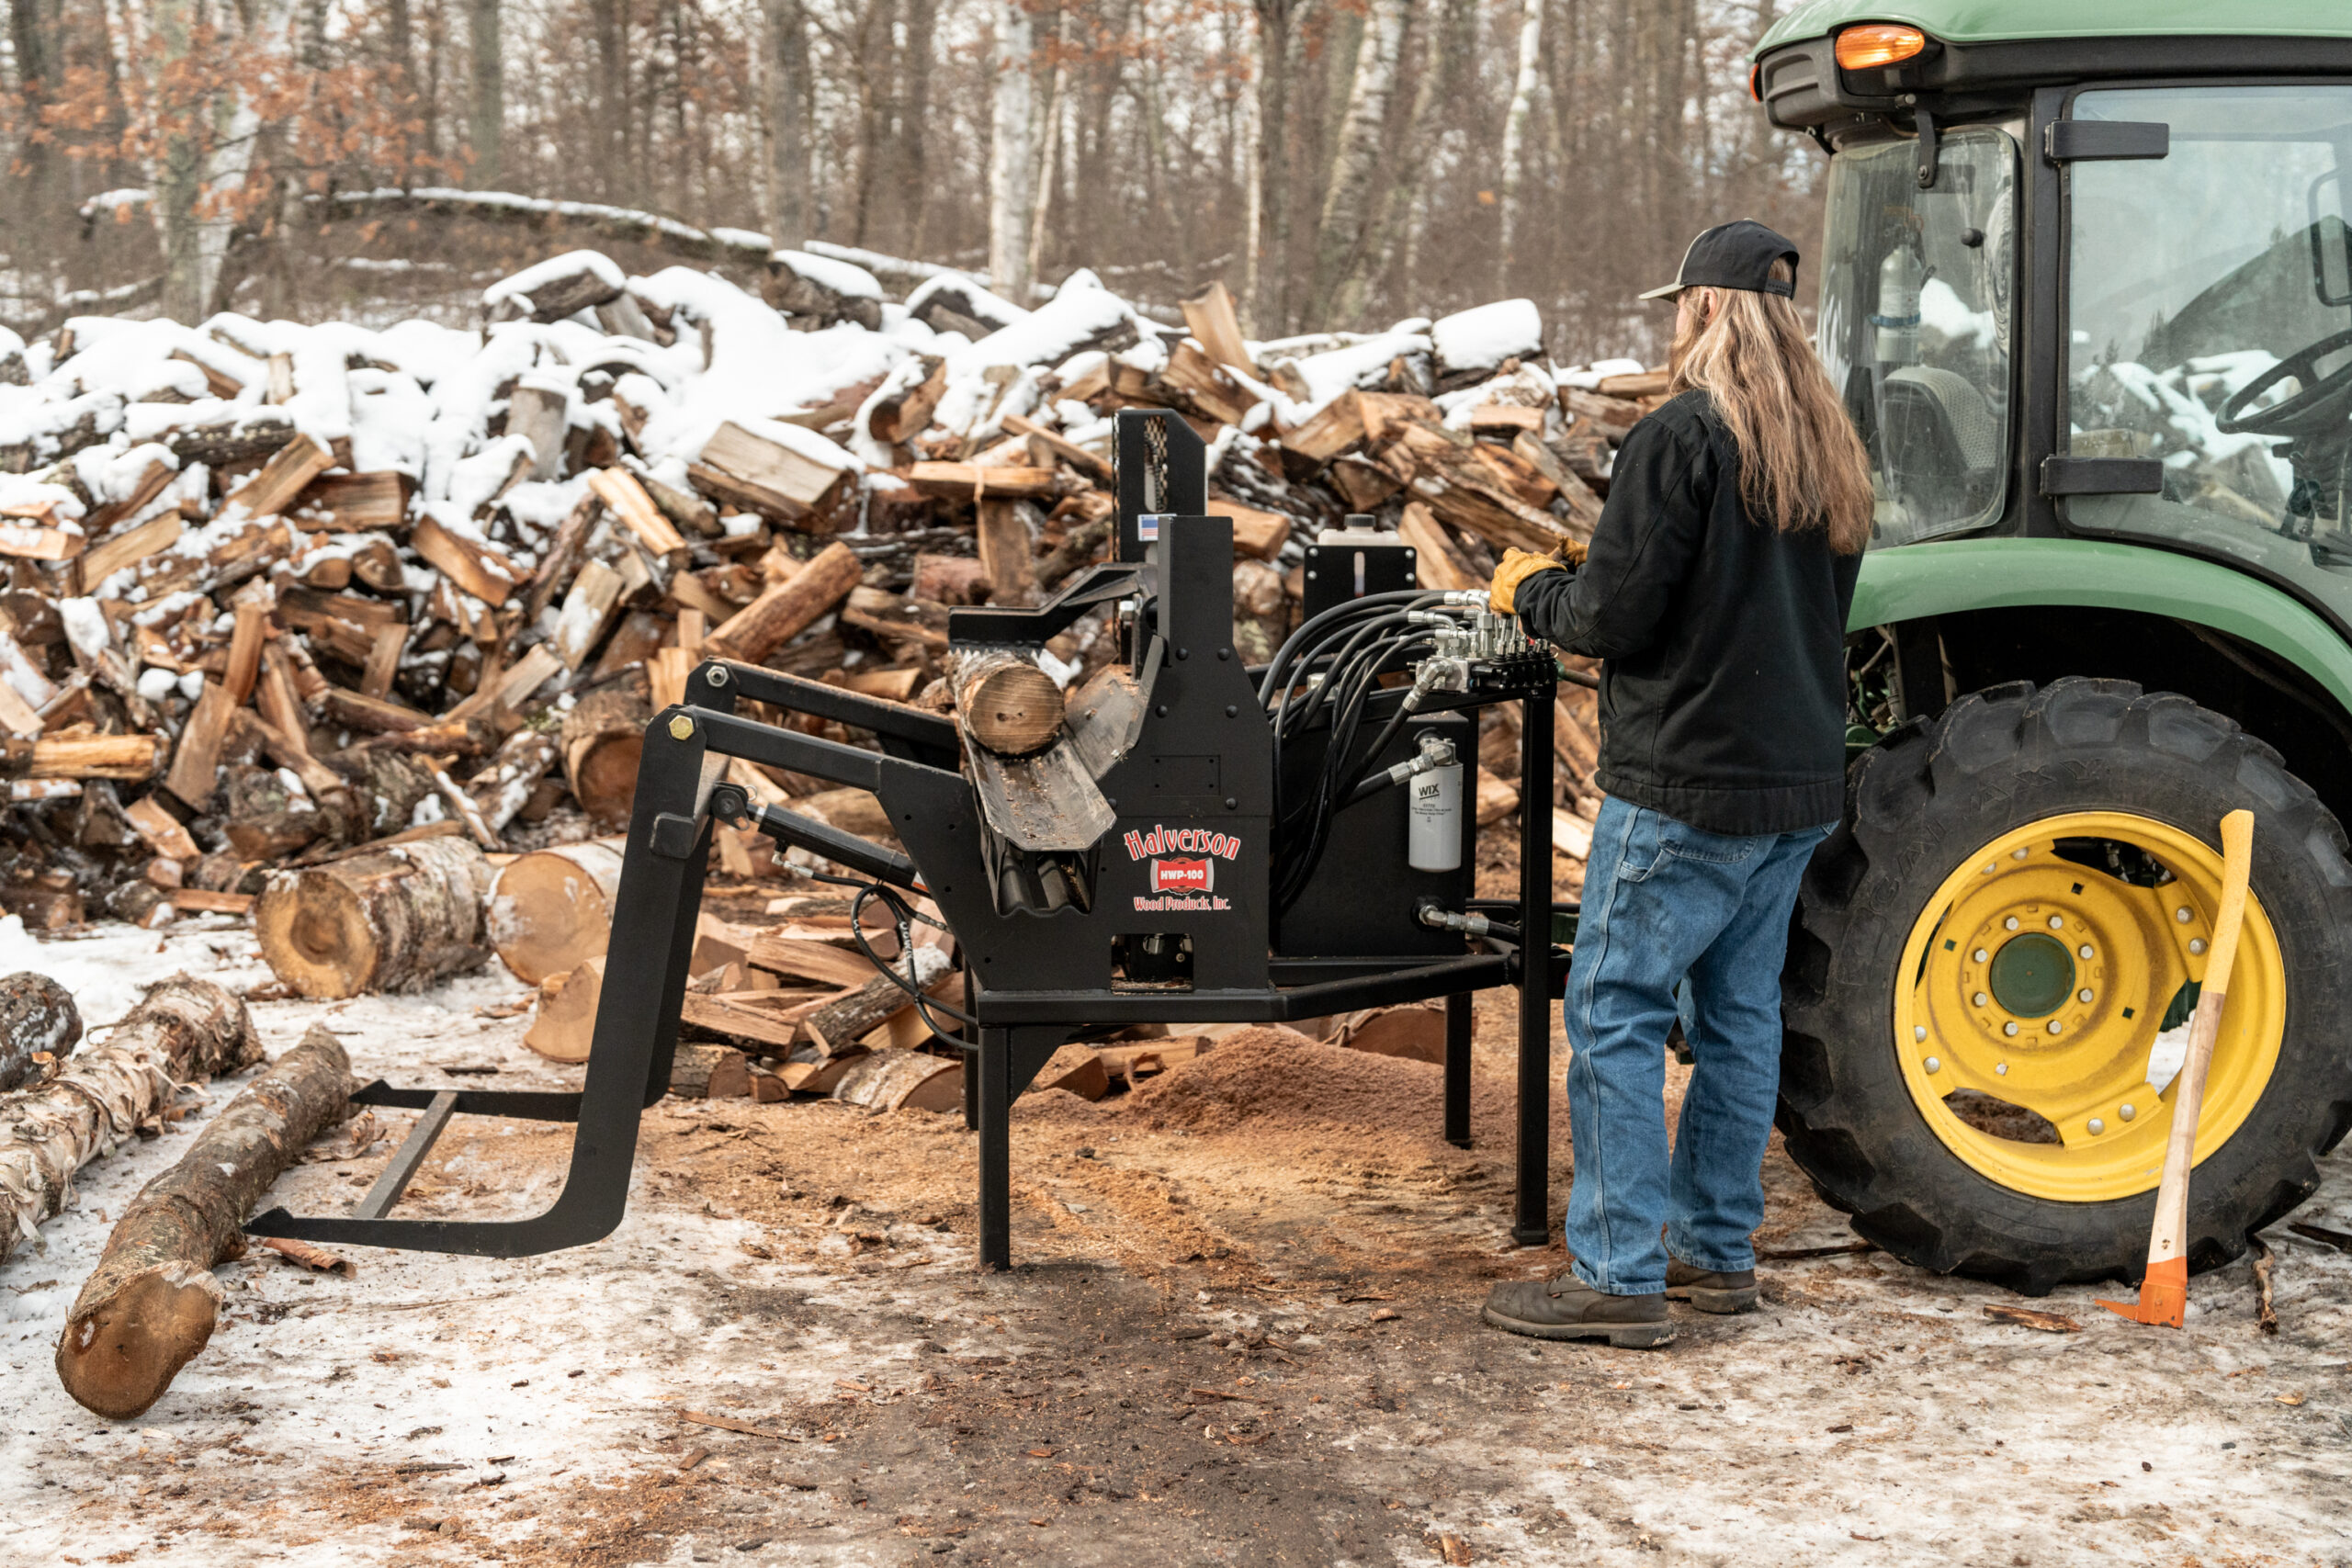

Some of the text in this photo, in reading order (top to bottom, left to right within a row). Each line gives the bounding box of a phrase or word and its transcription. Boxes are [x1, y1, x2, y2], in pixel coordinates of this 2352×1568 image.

[1419, 784, 1440, 797] WIX
[1124, 824, 1240, 862] Halverson
[1160, 870, 1204, 881] HWP-100
[1134, 896, 1231, 911] Wood Products, Inc.
